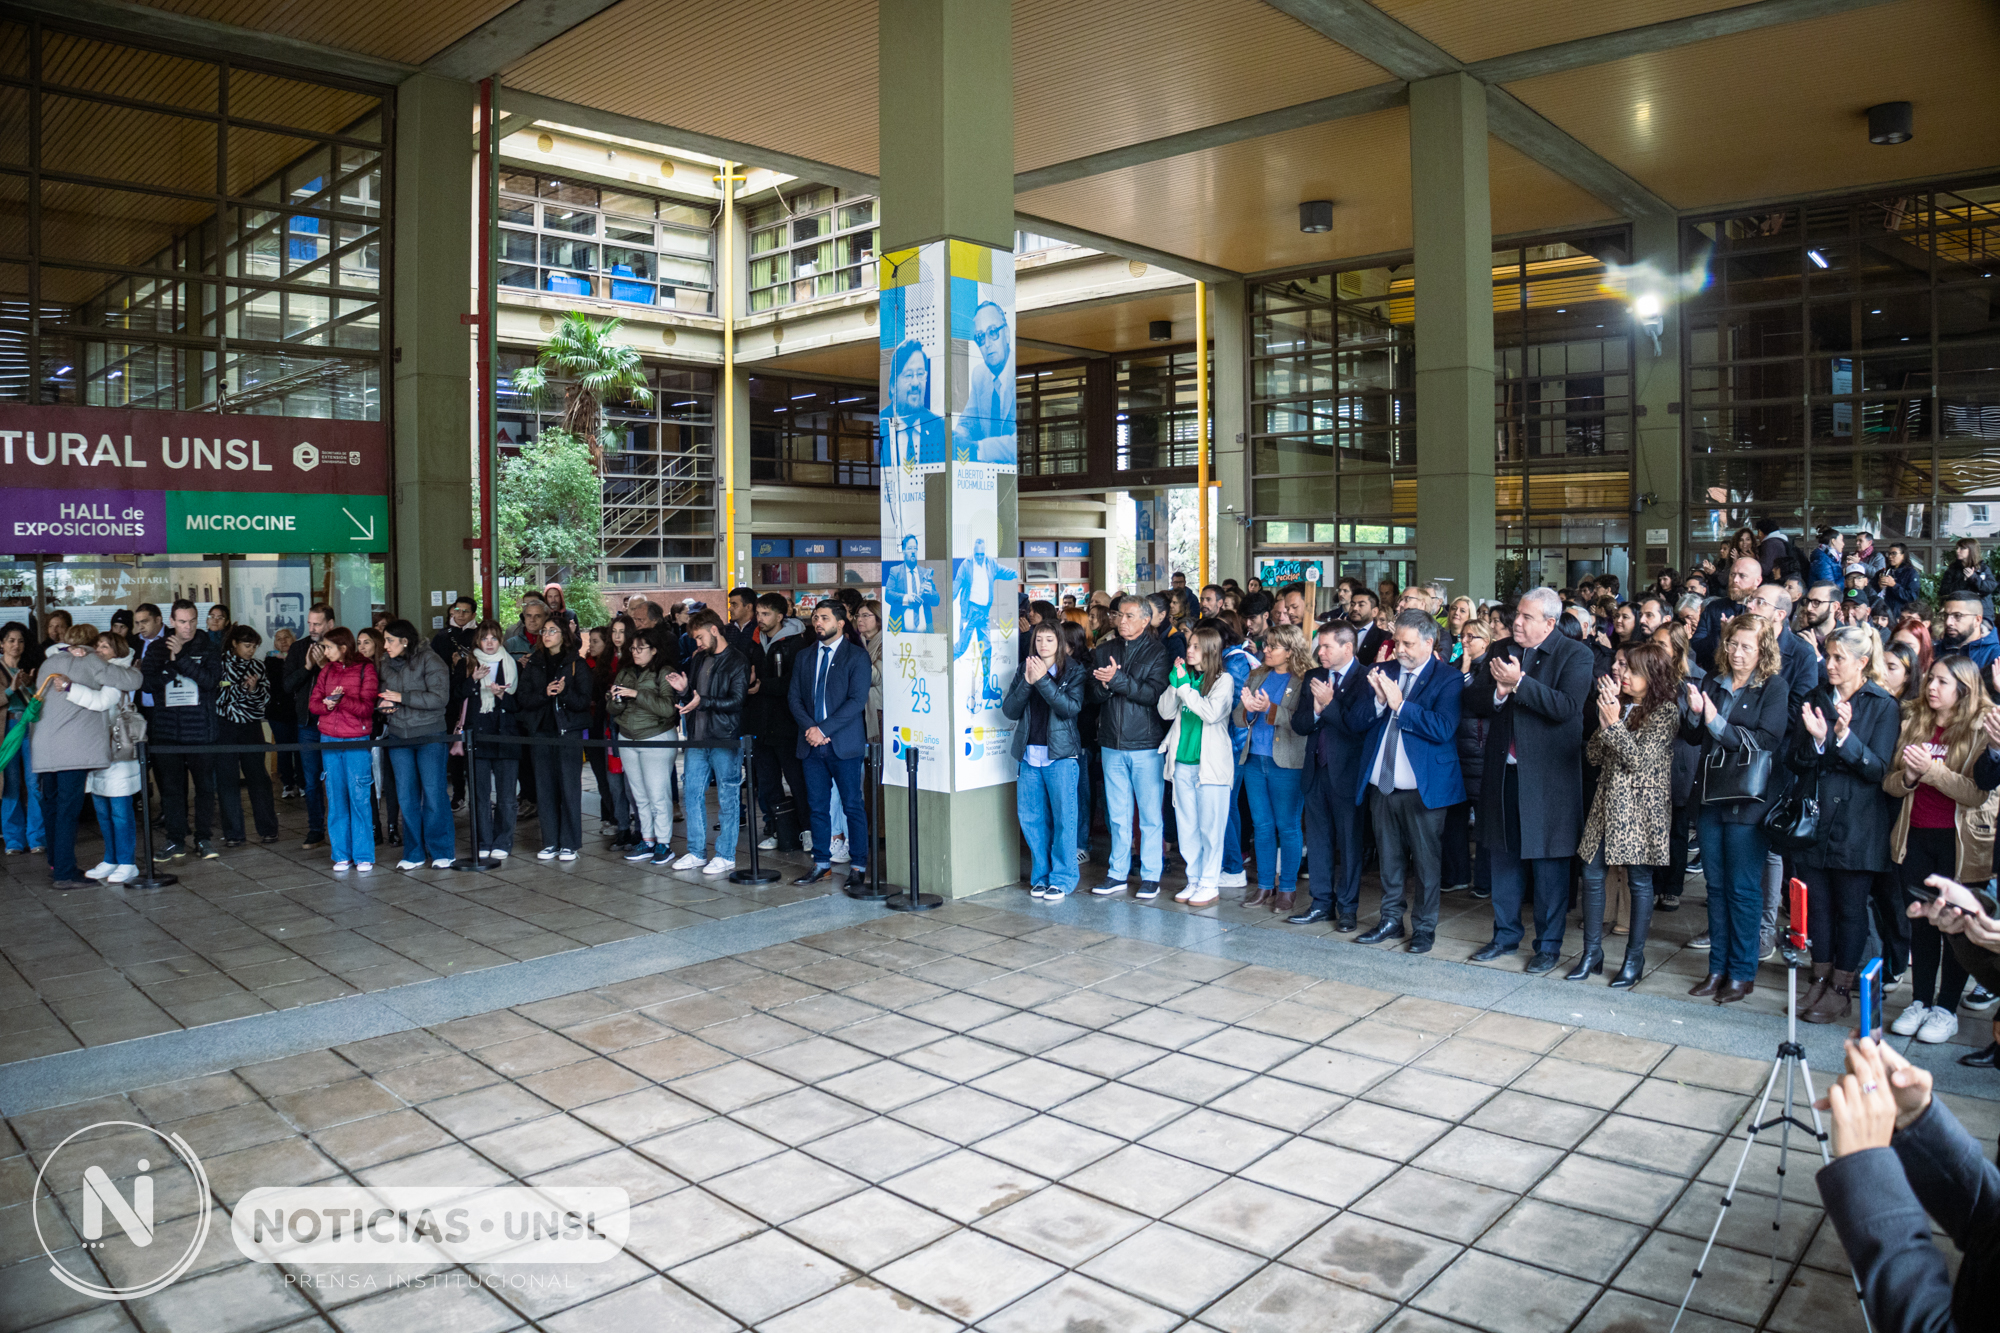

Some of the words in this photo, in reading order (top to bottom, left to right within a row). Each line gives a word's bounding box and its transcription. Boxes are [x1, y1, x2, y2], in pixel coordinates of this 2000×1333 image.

[162, 437, 273, 471] UNSL
[958, 469, 984, 480] ALBERTO
[902, 492, 926, 502] QUINTAS
[60, 503, 116, 520] HALL
[122, 506, 145, 521] de
[14, 522, 145, 537] EXPOSICIONES
[186, 515, 297, 531] MICROCINE
[814, 544, 825, 553] RICO
[900, 642, 912, 660] 19
[900, 658, 916, 679] 73
[911, 677, 927, 695] 20
[911, 691, 931, 714] 23
[913, 730, 924, 743] 50
[924, 735, 940, 745] años
